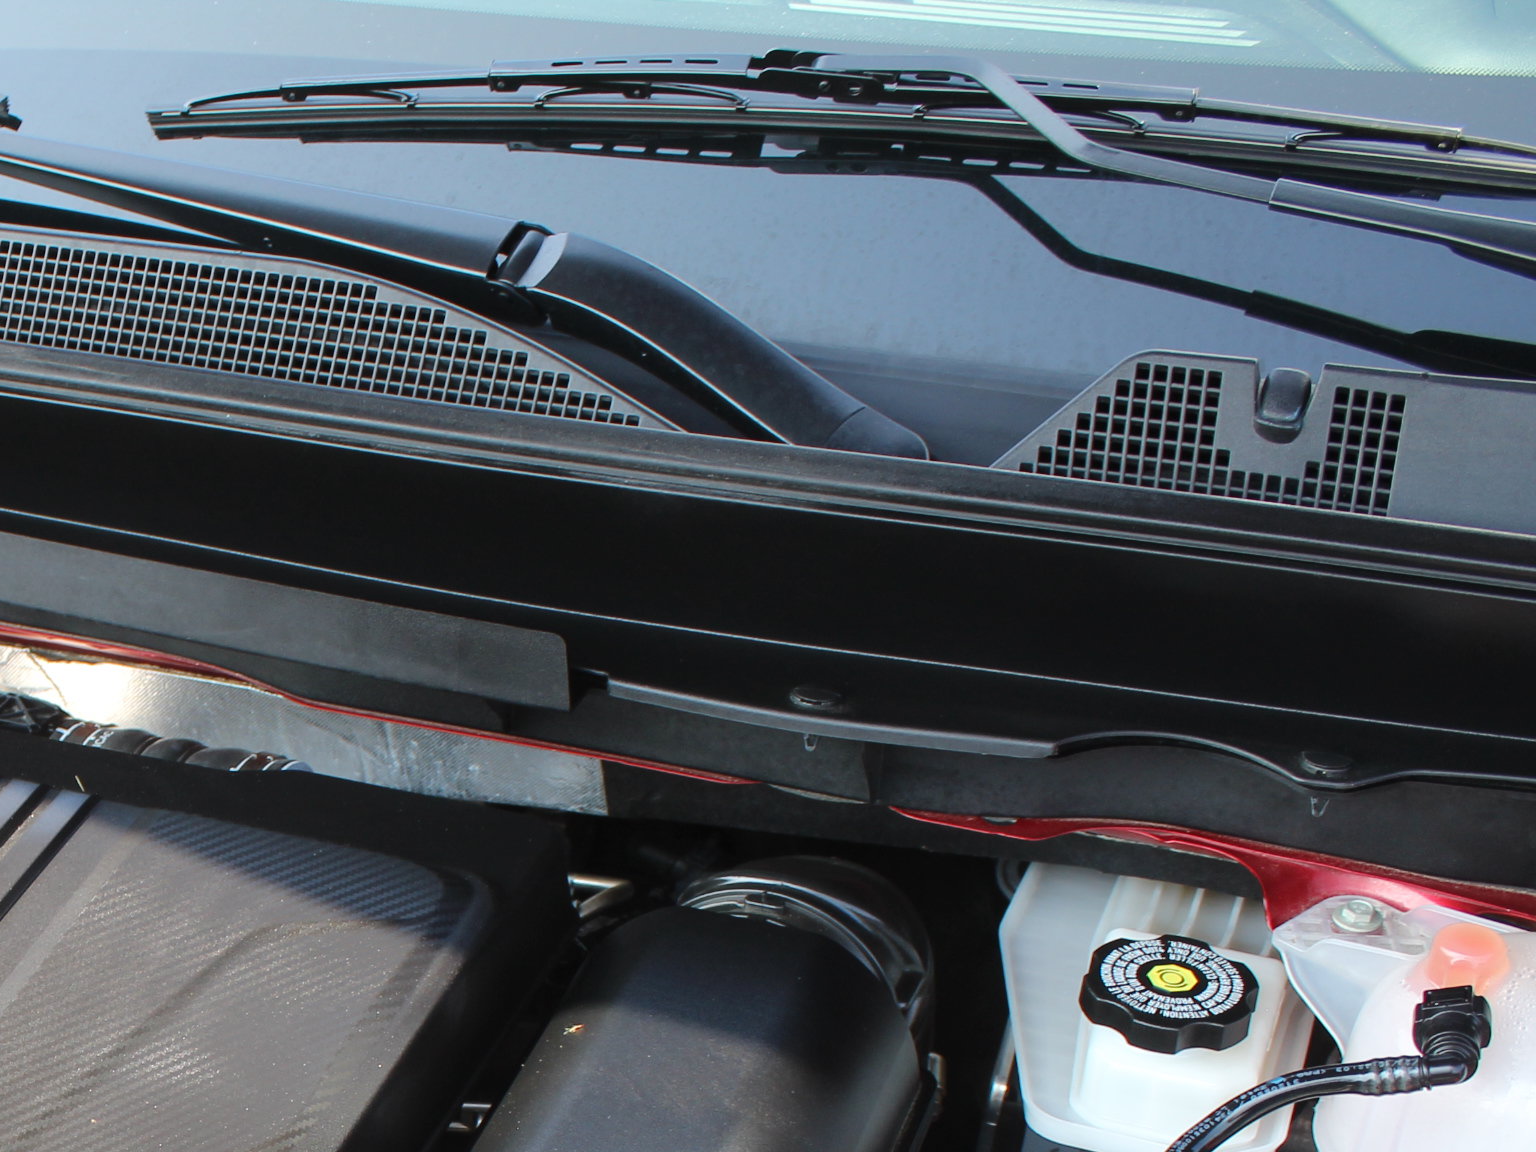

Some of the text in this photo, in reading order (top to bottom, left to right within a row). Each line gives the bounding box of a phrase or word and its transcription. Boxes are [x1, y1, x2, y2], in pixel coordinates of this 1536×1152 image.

[1166, 946, 1190, 955] ONLY
[1167, 939, 1219, 958] CONTAINER.
[1107, 986, 1121, 994] LE
[1140, 989, 1195, 1004] PROVENANT
[1114, 993, 1157, 1014] NETTOYER
[1128, 992, 1148, 1003] QUE
